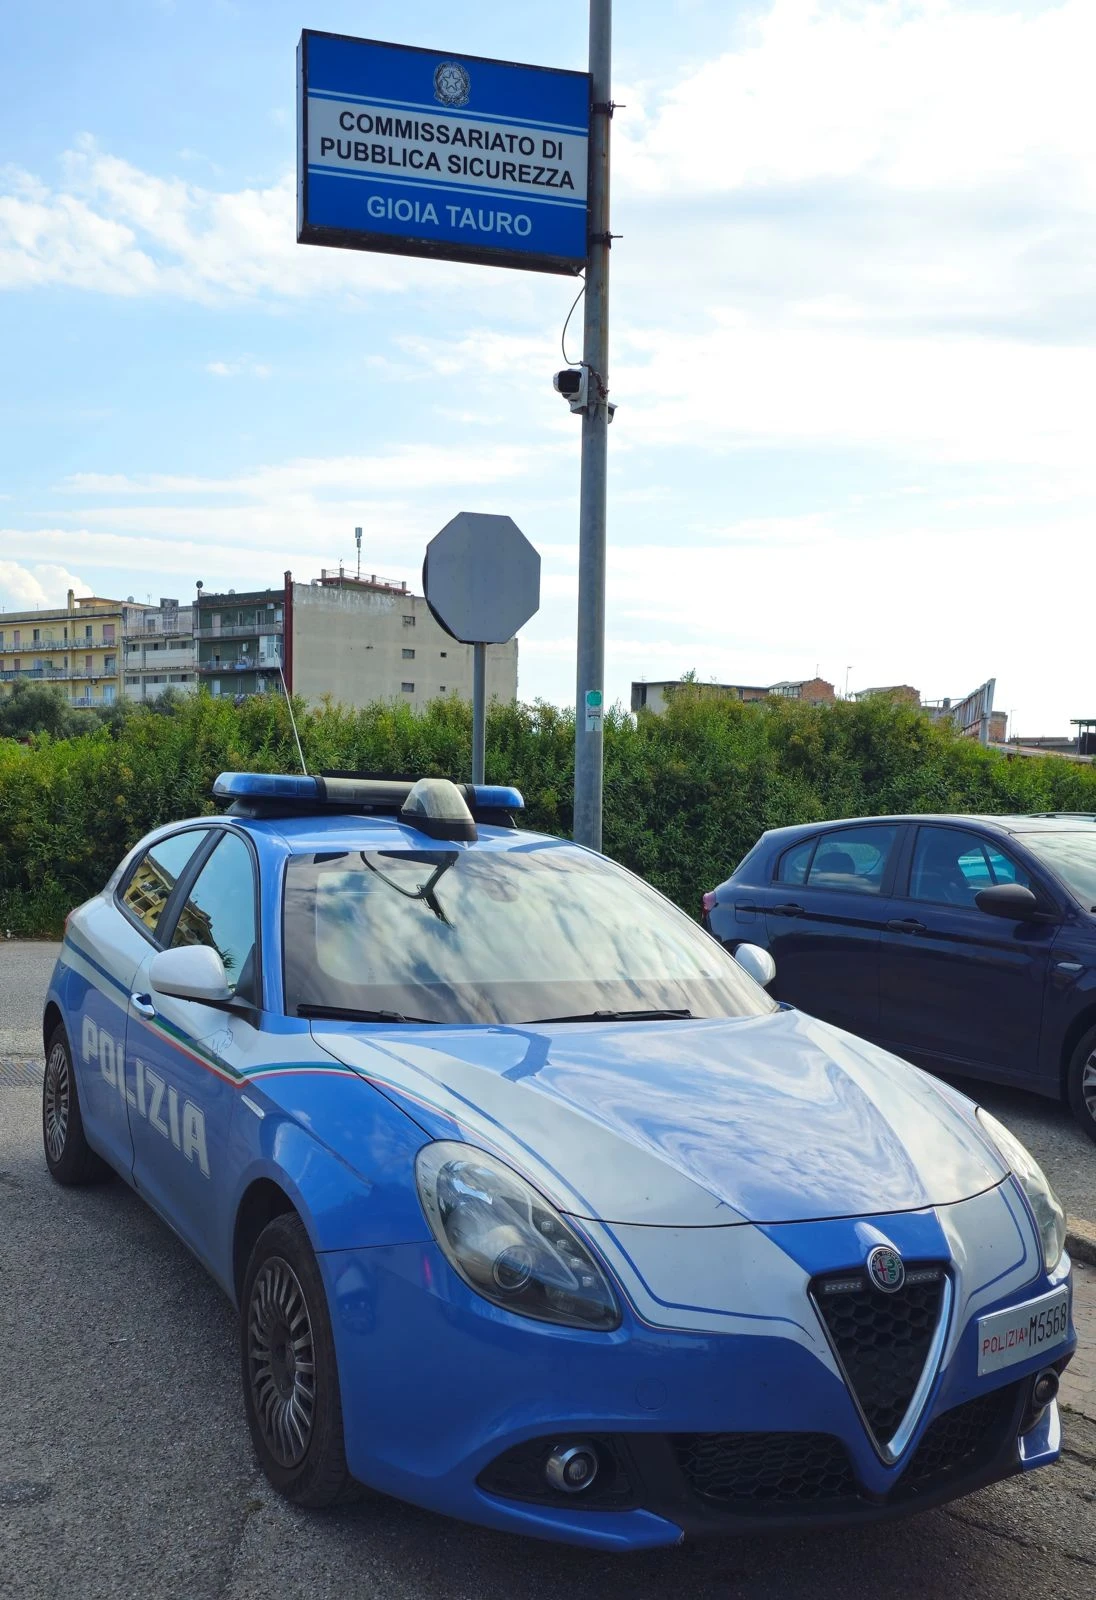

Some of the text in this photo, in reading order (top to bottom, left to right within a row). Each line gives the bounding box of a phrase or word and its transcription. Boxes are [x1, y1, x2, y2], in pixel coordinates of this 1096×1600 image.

[339, 111, 563, 160] COMMISSARIATO DI
[320, 137, 575, 190] PUBBLICA SICUREZZA
[367, 195, 532, 236] GIOIA TAURO
[82, 1014, 211, 1180] POLIZIA
[982, 1302, 1067, 1355] POLIZIA M5568
